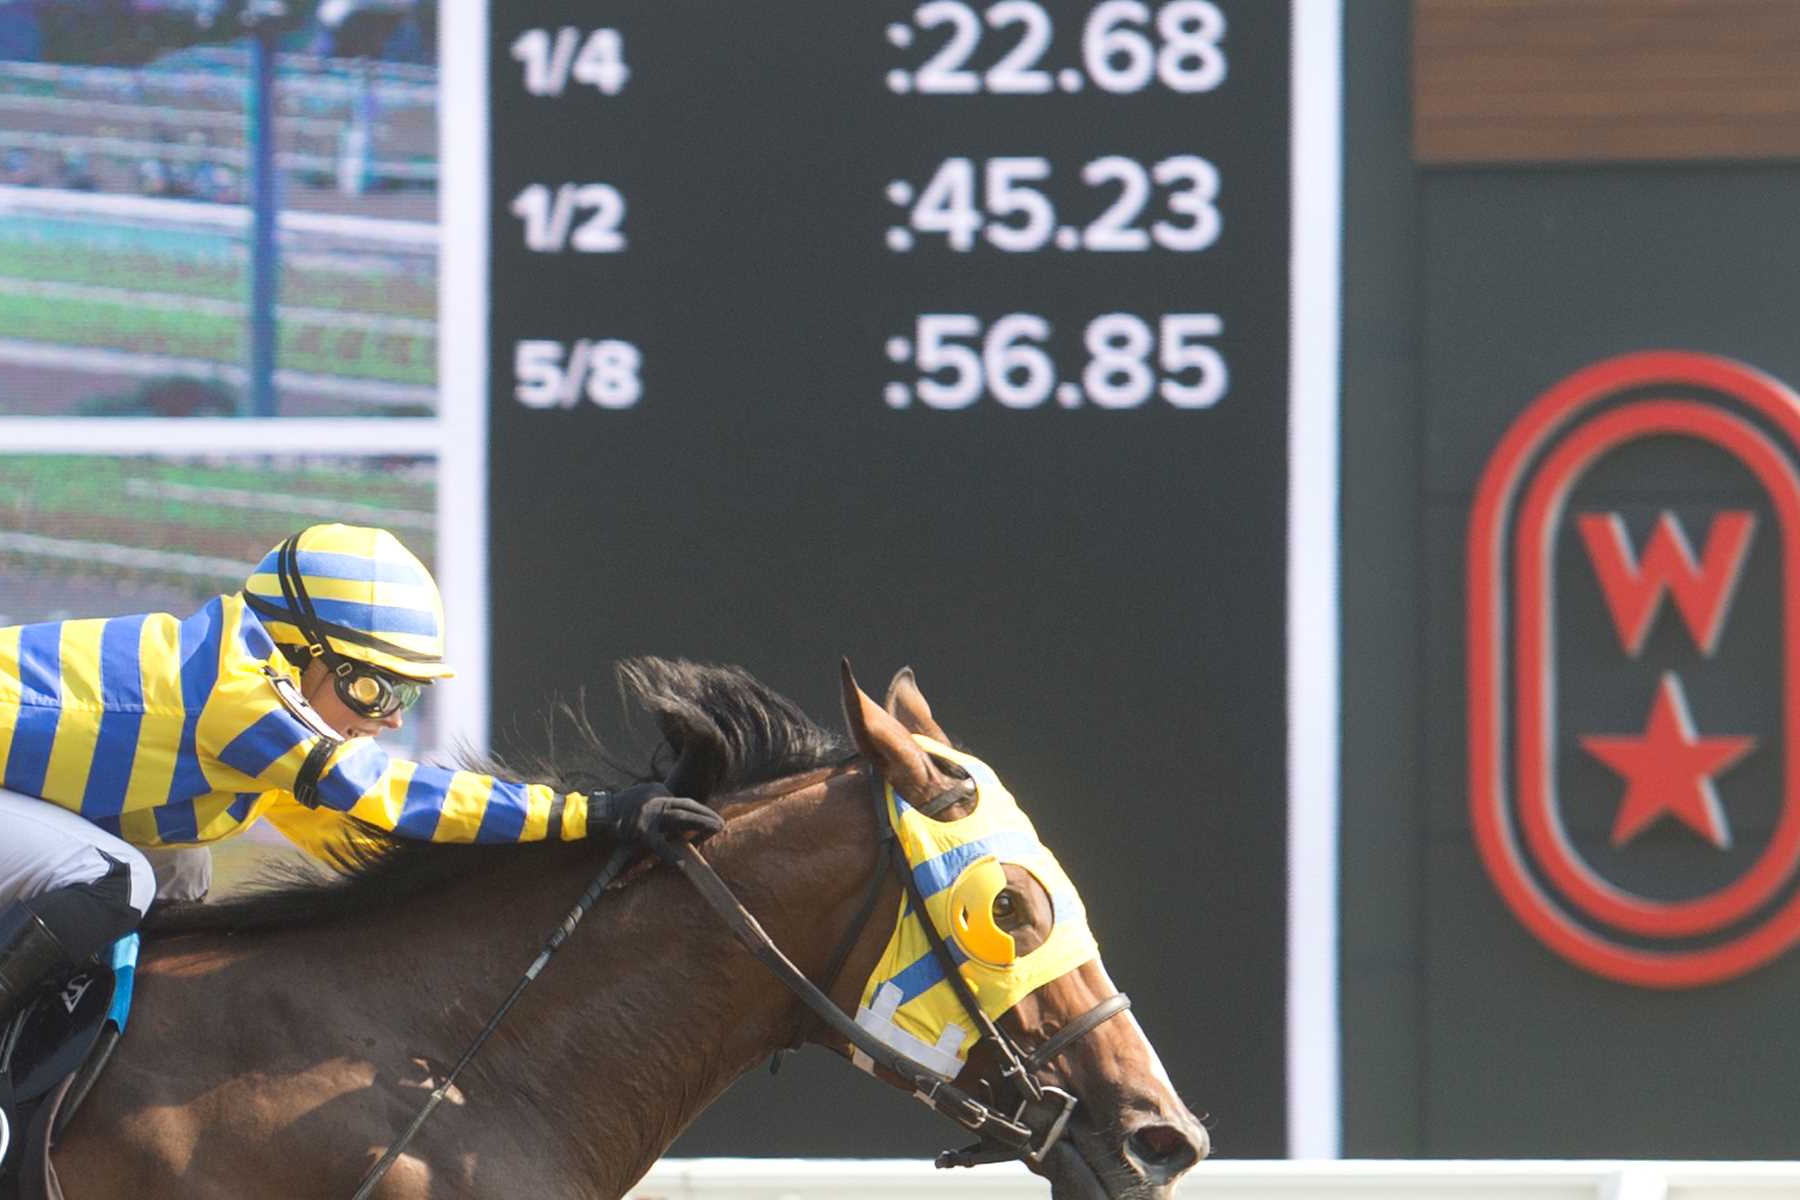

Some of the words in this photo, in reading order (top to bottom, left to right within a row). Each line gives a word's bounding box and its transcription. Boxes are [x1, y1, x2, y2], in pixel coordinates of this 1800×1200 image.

[511, 26, 628, 95] 1/4
[886, 0, 1227, 93] :22.68
[511, 183, 626, 253] 1/2
[886, 155, 1221, 253] :45.23
[513, 339, 642, 409] 5/8
[885, 313, 1228, 409] :56.85
